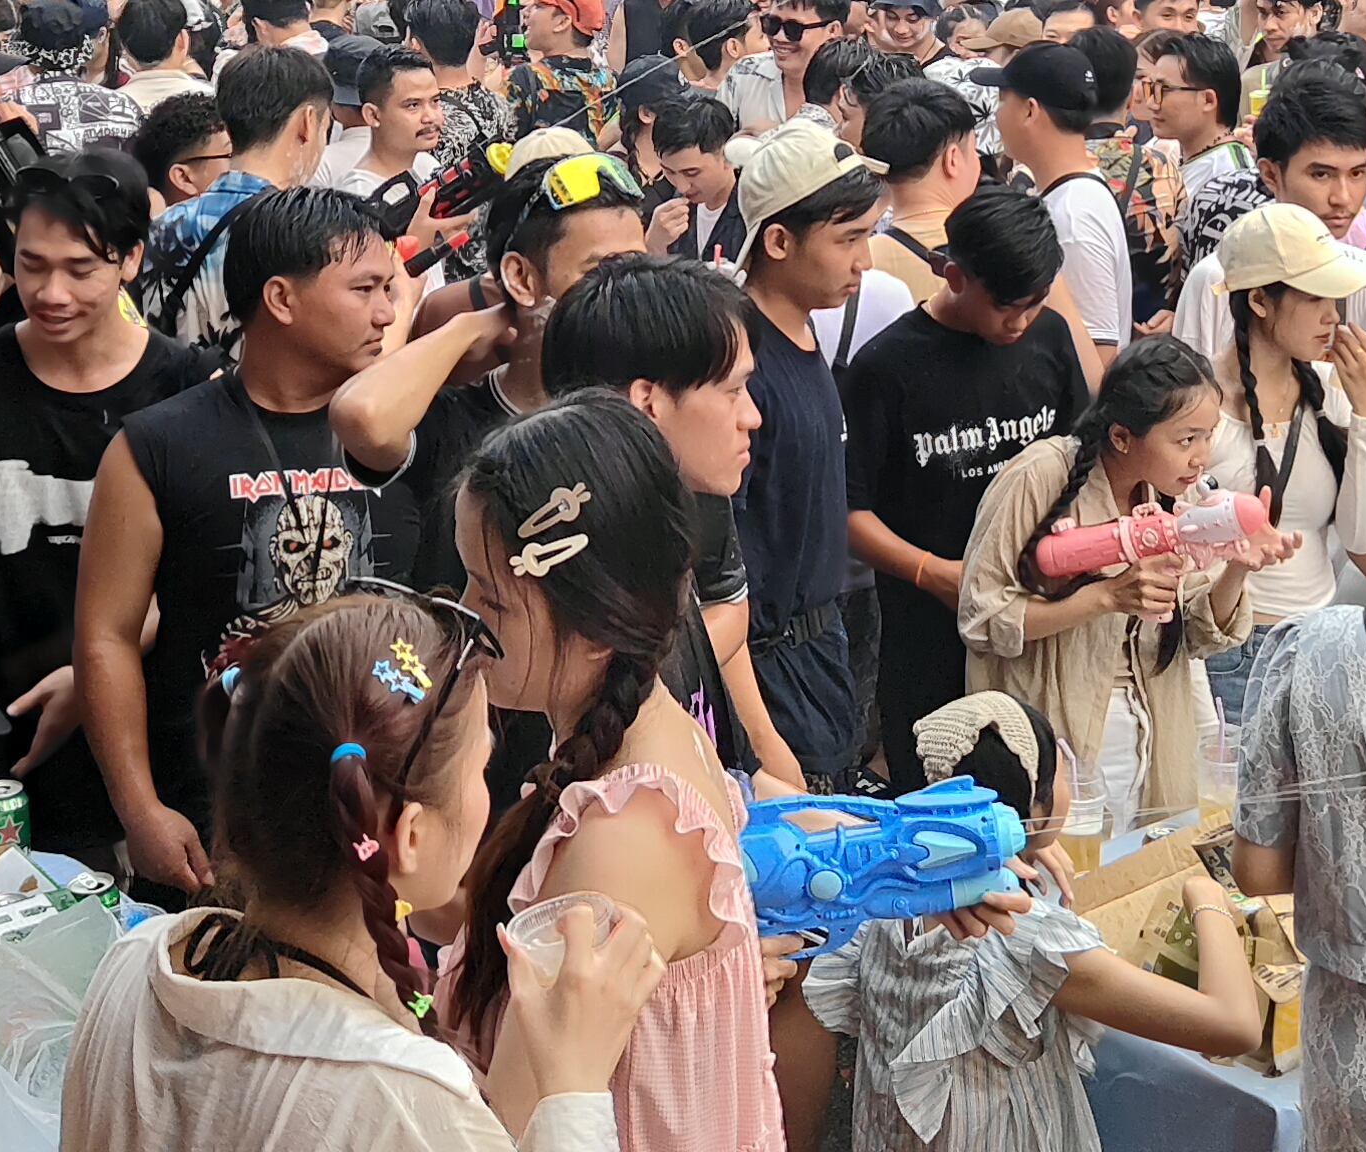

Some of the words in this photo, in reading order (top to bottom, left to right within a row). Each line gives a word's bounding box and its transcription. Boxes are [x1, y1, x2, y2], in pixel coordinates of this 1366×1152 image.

[913, 423, 986, 468] Palm
[985, 404, 1056, 450] Angels
[961, 466, 984, 479] LOS
